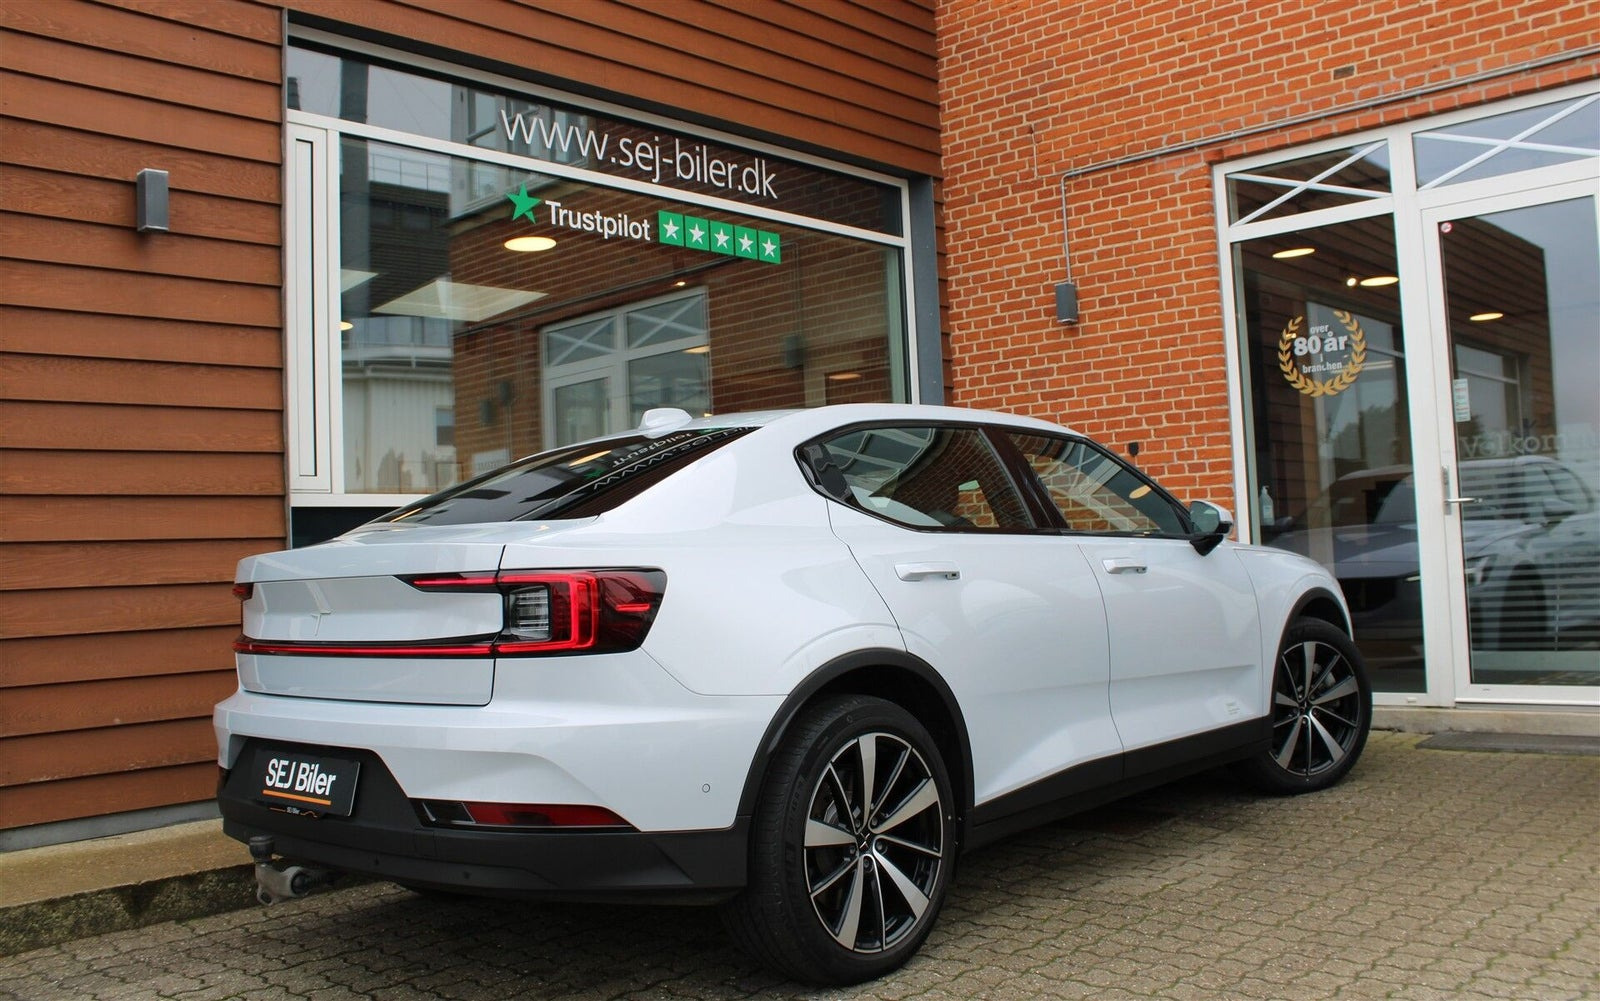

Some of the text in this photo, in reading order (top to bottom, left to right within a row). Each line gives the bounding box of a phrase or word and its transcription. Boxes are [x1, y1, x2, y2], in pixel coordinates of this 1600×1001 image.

[500, 109, 778, 199] www.sej-biler.dk
[545, 200, 651, 241] Trustpilot
[1294, 331, 1348, 356] 80 år
[1310, 324, 1329, 334] over
[265, 758, 337, 796] SEJ Biler
